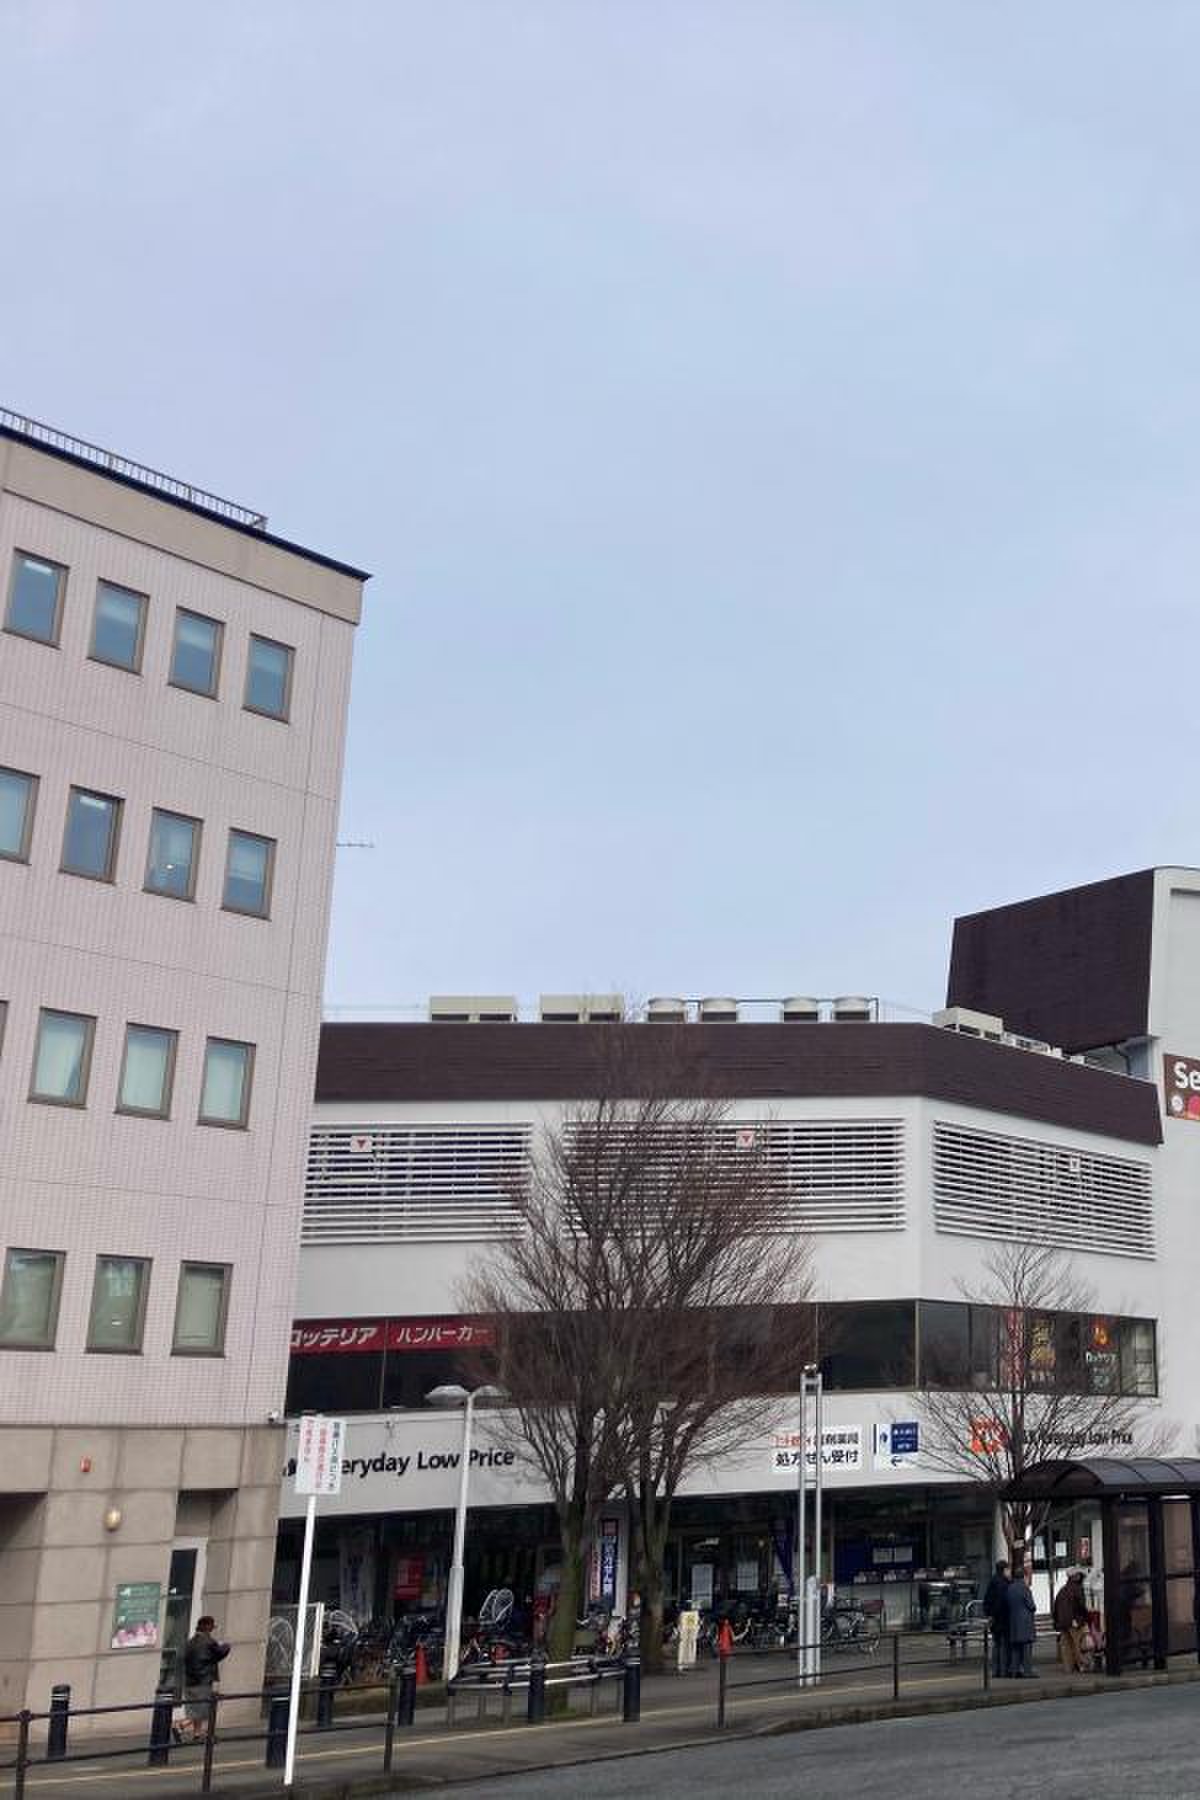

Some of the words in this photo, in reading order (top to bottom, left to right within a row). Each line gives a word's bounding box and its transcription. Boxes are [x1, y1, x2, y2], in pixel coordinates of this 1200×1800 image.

[341, 1453, 411, 1476] eryday
[417, 1450, 460, 1470] Low
[468, 1447, 515, 1468] Price
